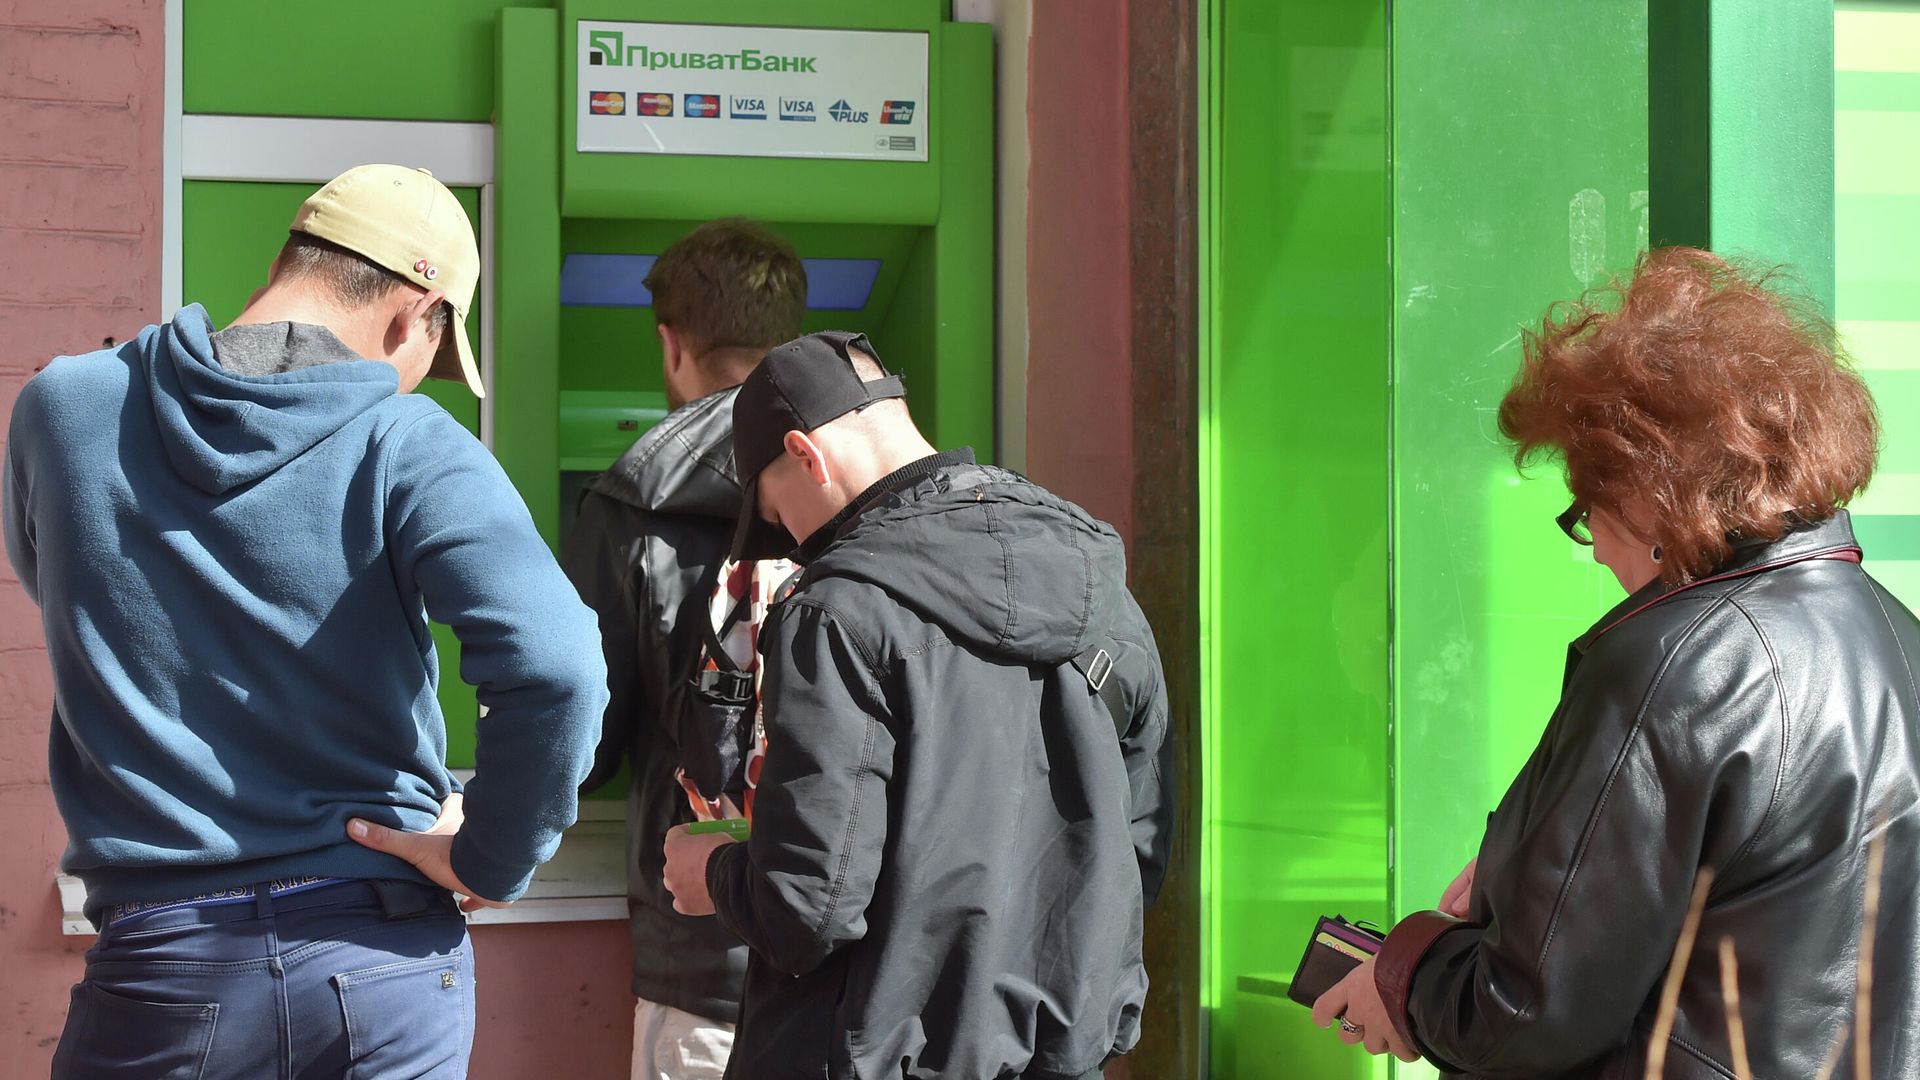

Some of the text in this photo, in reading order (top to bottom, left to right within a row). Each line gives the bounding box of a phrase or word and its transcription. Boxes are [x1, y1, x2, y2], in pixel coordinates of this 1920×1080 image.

[627, 45, 817, 73] ПриватБанк
[735, 99, 765, 111] VISA
[784, 100, 815, 113] VISA
[839, 111, 869, 123] PLUS
